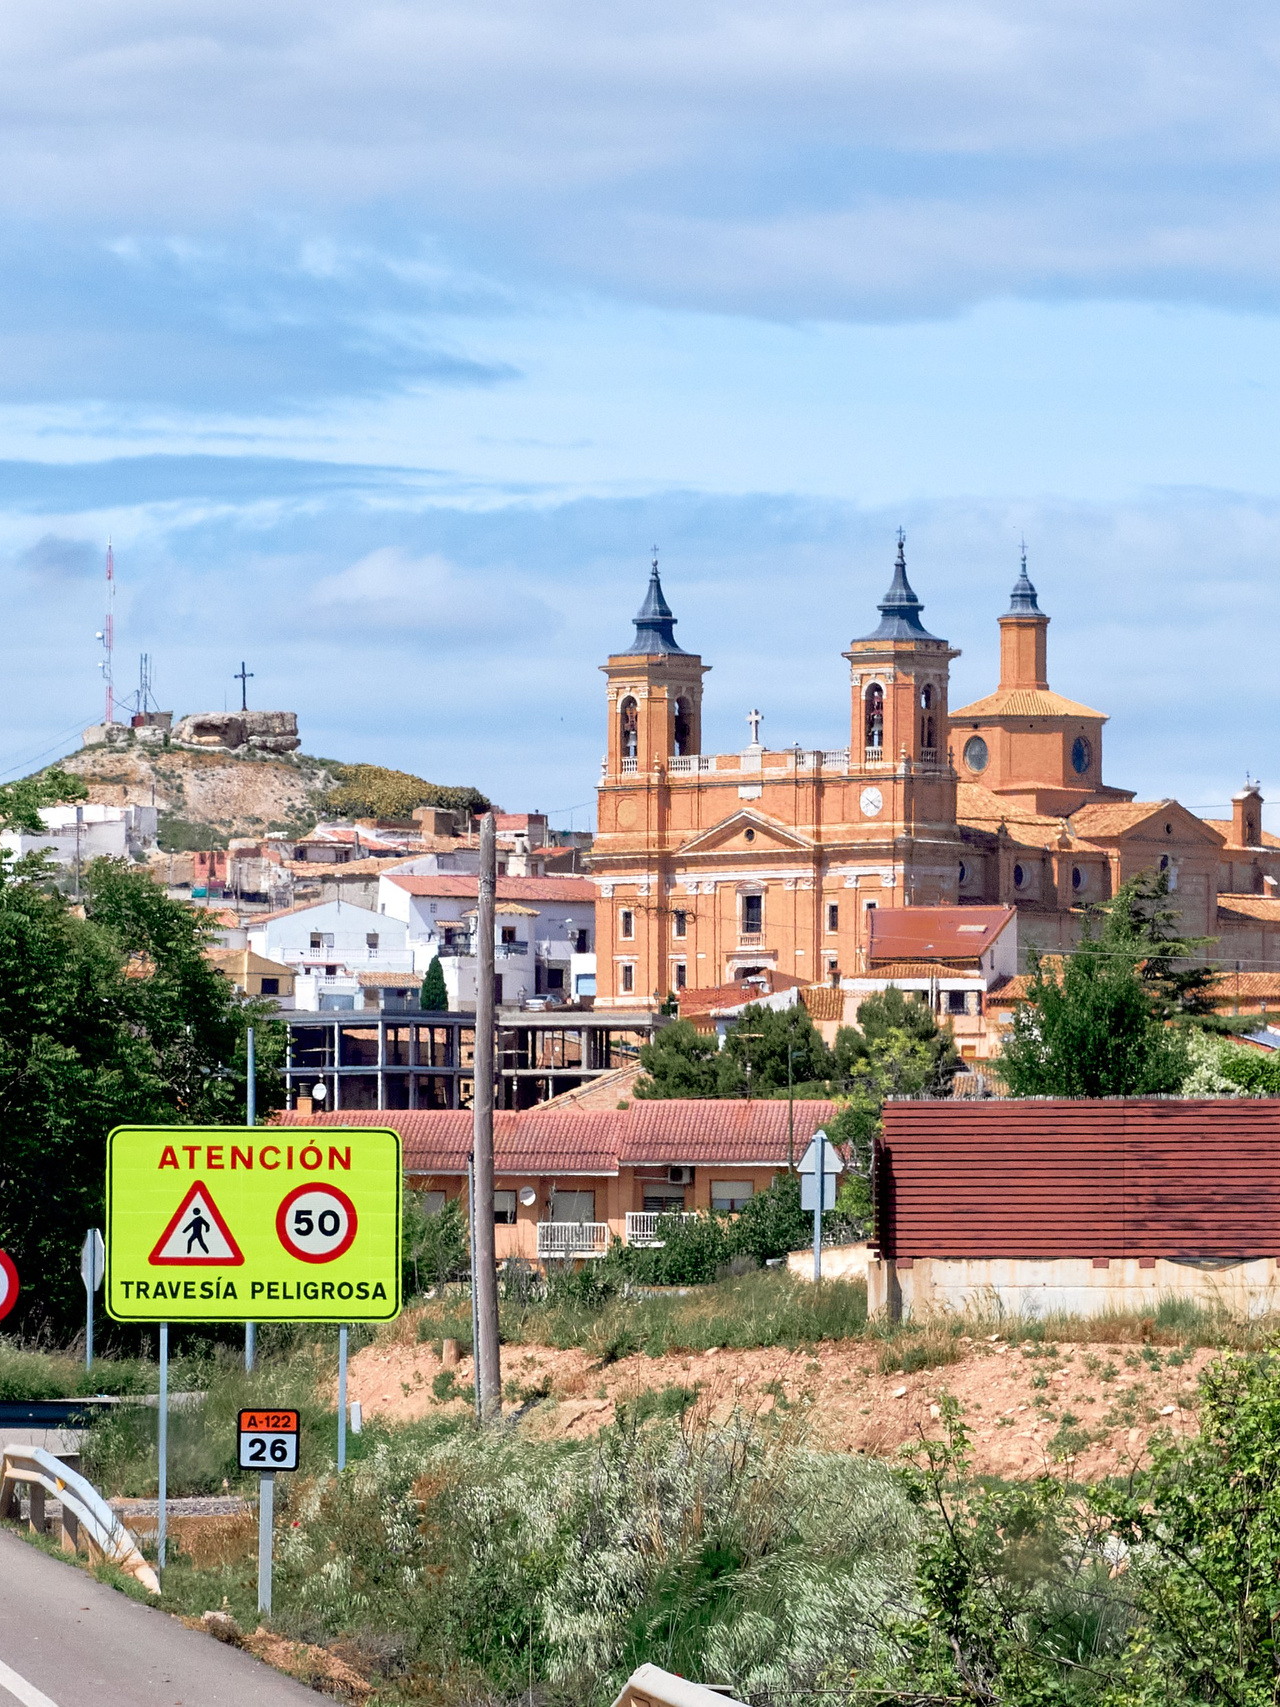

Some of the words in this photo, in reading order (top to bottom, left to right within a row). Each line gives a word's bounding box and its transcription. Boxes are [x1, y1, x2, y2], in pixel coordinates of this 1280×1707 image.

[157, 1139, 351, 1171] ATENCIÓN
[293, 1209, 341, 1237] 50
[120, 1276, 238, 1300] TRAVESÍA
[251, 1281, 388, 1301] PELIGROSA
[247, 1415, 291, 1428] A-122
[248, 1437, 288, 1463] 26
